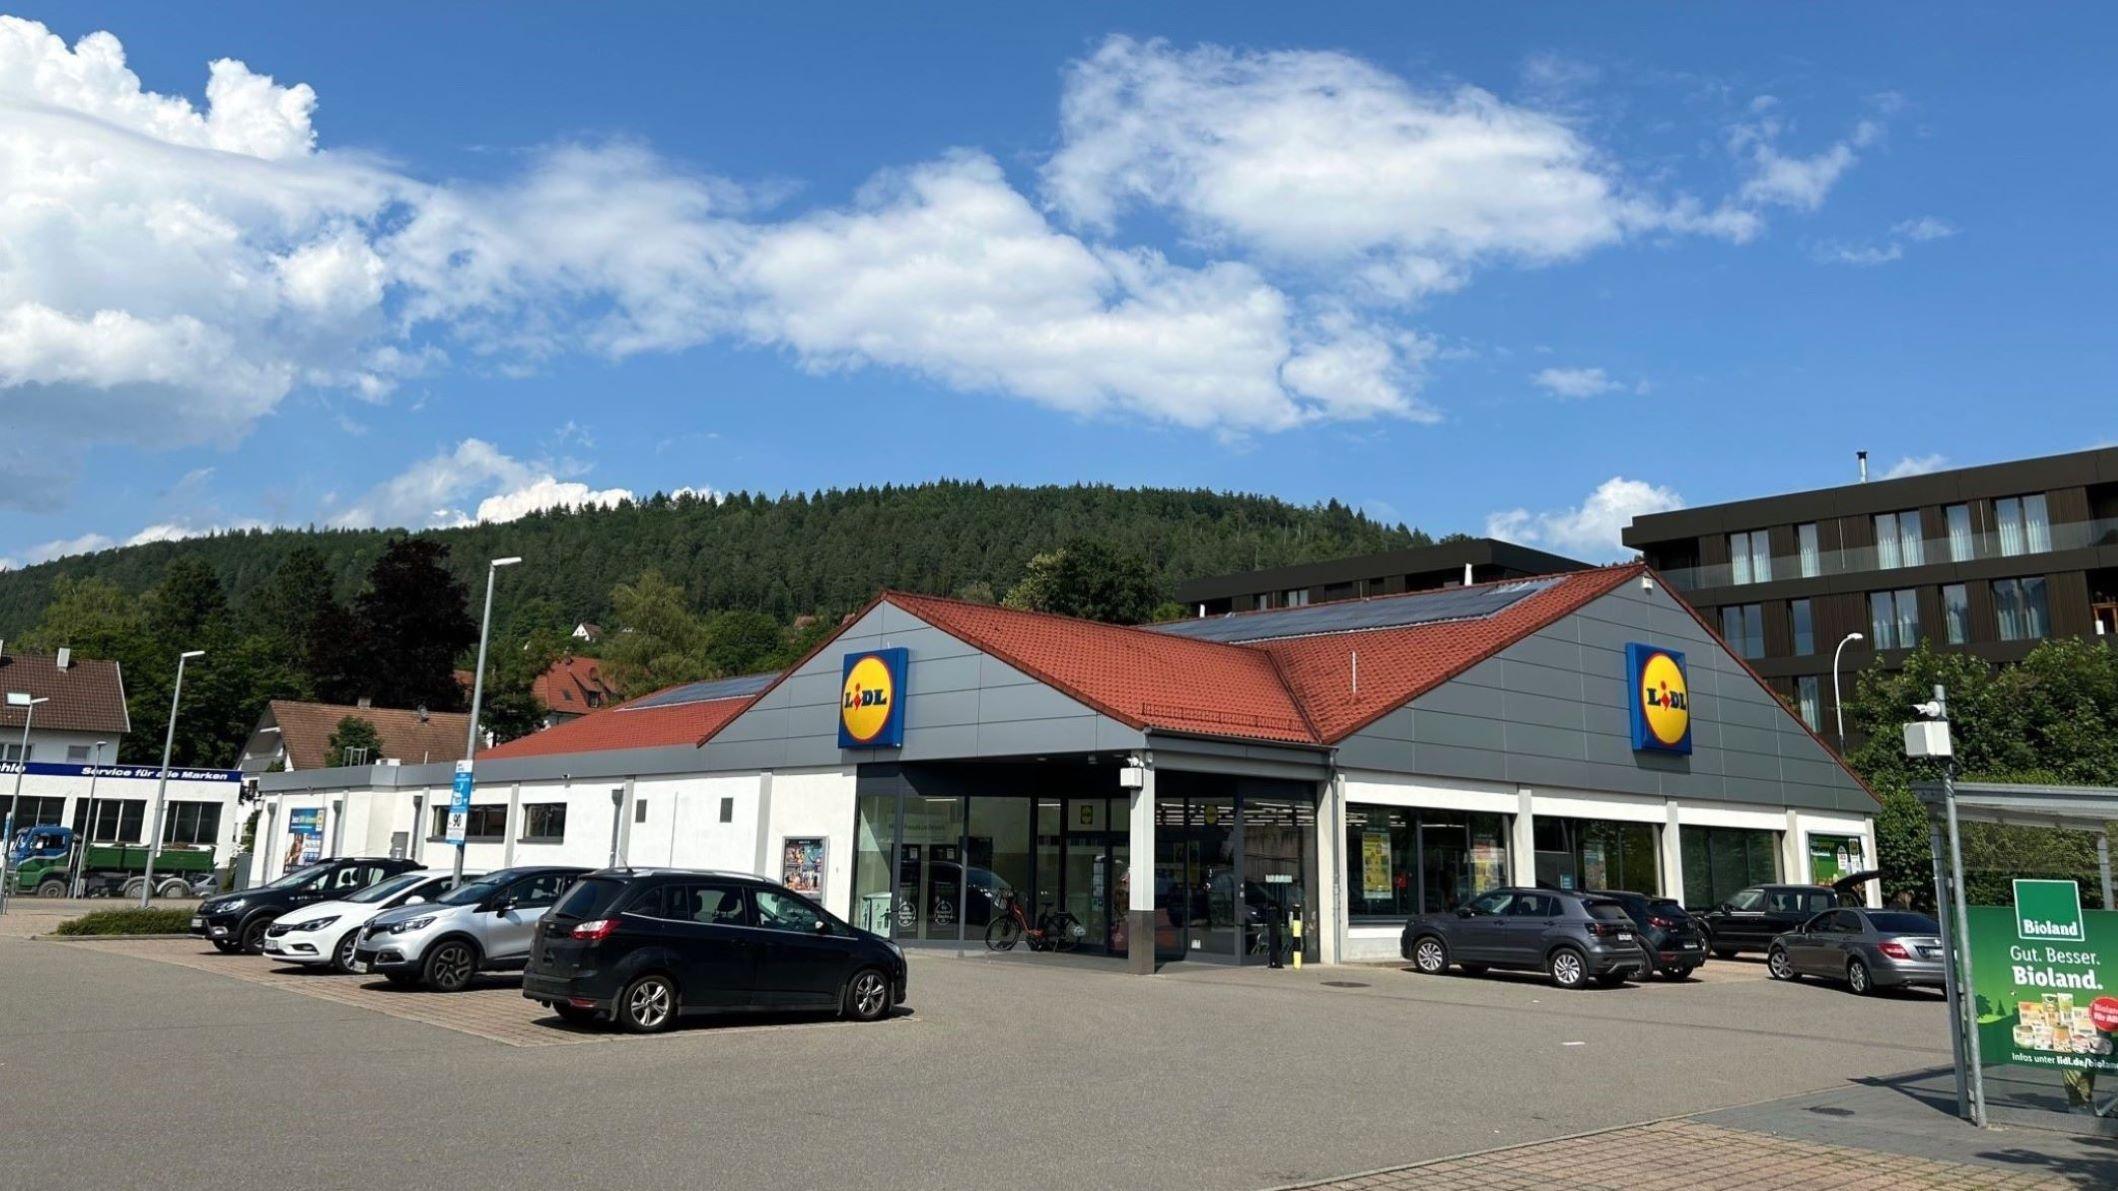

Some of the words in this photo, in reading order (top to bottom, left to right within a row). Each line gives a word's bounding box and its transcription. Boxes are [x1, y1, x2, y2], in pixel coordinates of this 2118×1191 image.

[844, 682, 888, 711] LIDL
[1646, 680, 1687, 711] LIDL
[181, 772, 229, 780] Marken
[2023, 918, 2079, 936] Bioland
[2010, 945, 2042, 962] Gut.
[2045, 946, 2101, 965] Besser.
[2012, 965, 2104, 990] Bioland.
[2012, 1052, 2033, 1063] Infos
[2034, 1055, 2056, 1064] unter
